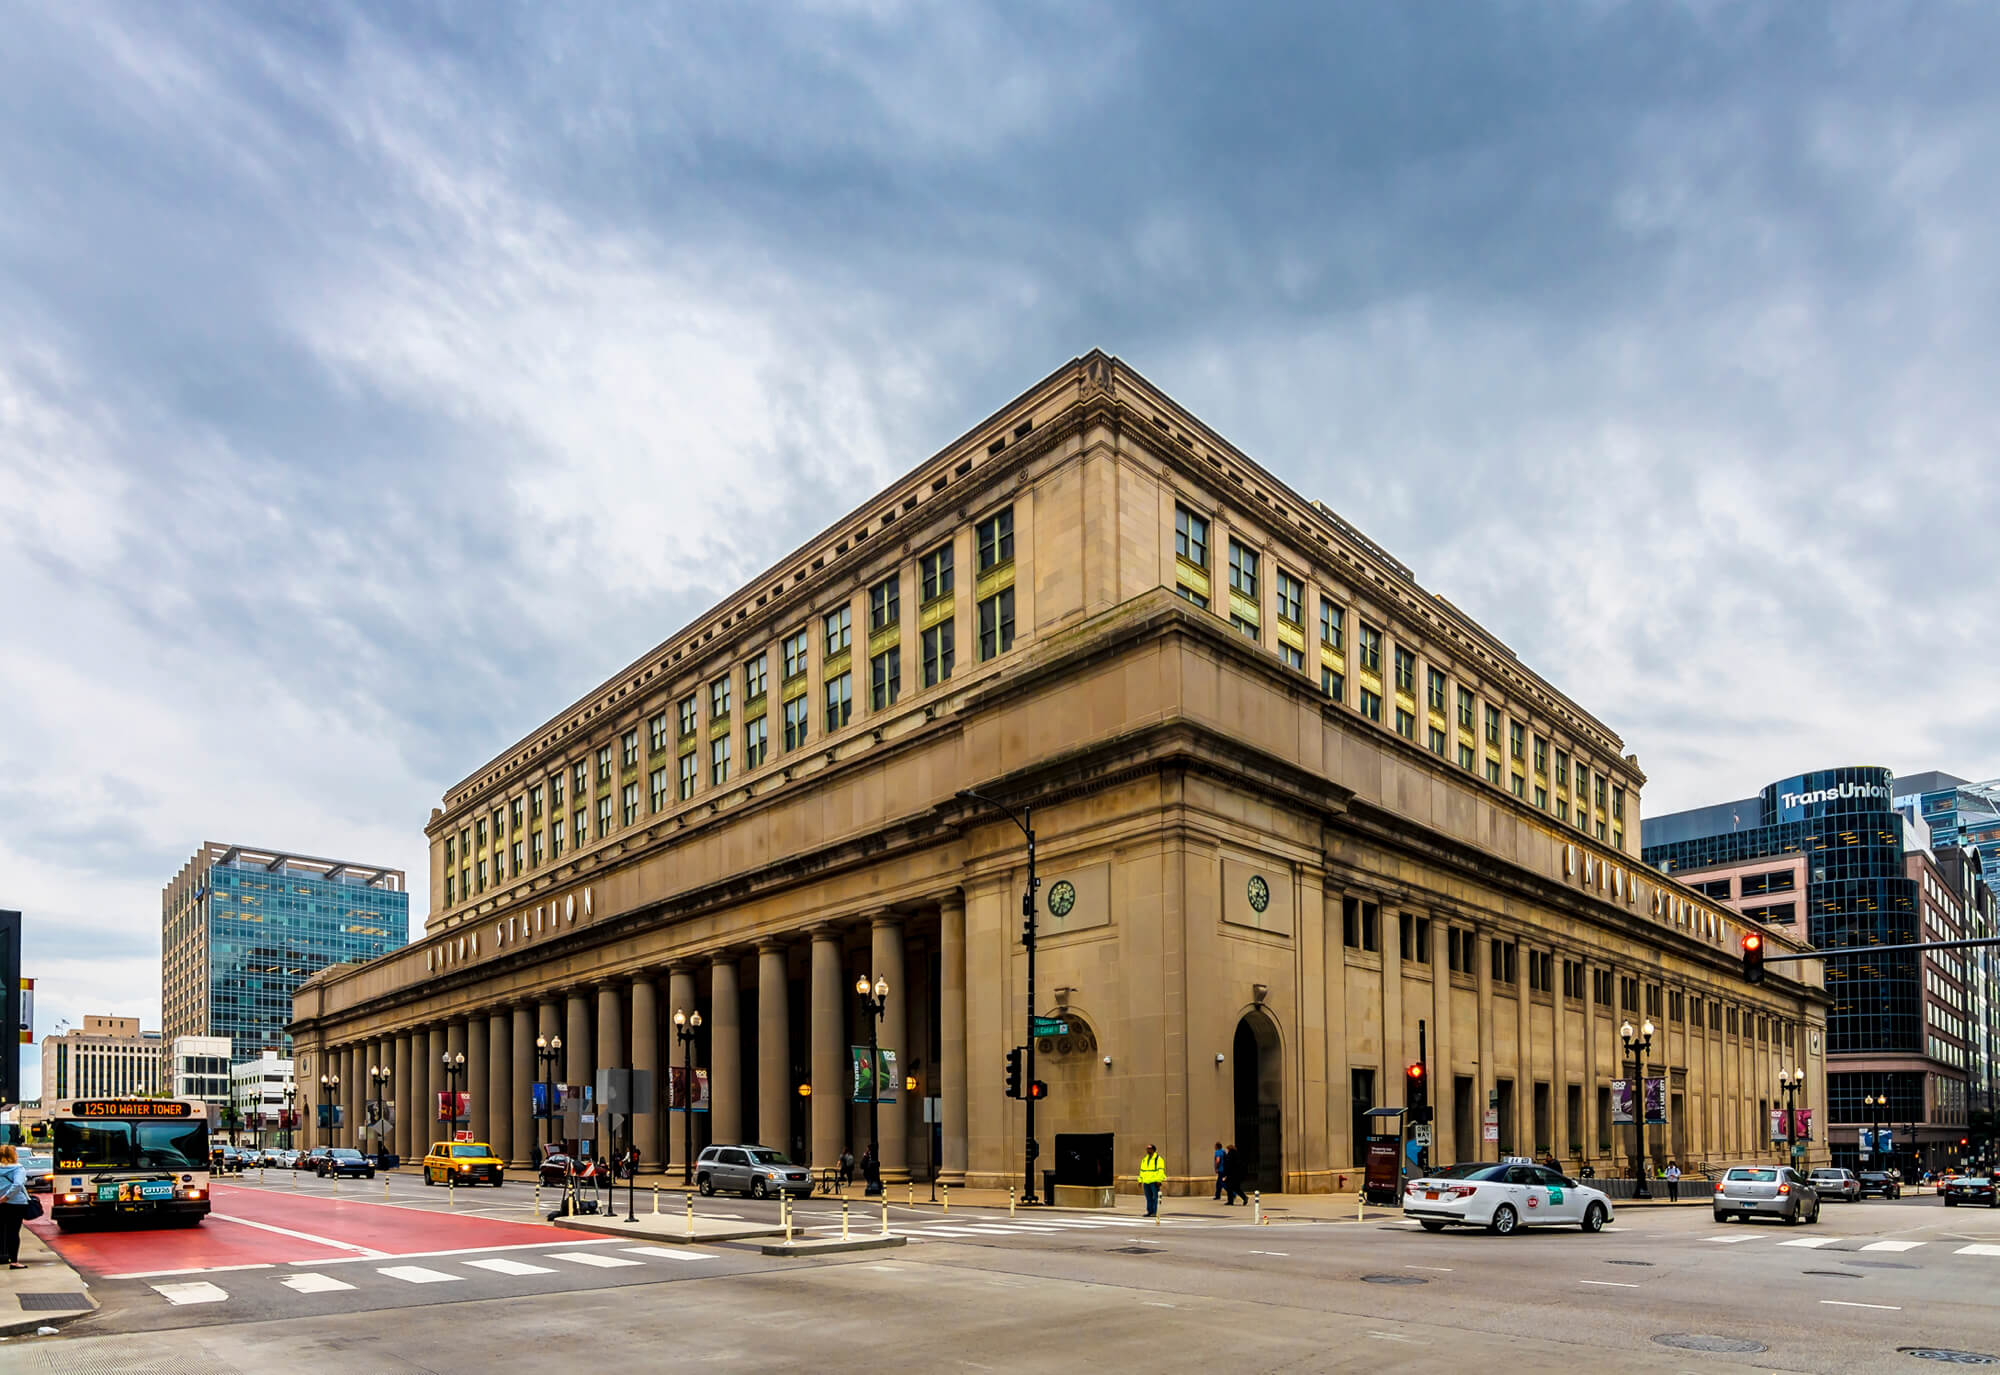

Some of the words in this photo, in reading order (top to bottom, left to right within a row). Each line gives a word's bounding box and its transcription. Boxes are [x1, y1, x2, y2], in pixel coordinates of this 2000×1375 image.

[1781, 782, 1890, 809] TransUnion
[1564, 844, 1637, 904] UNION
[1654, 888, 1725, 942] STATION
[427, 931, 480, 971] UNION
[497, 887, 594, 947] STATION
[84, 1103, 105, 1115] 125
[119, 1104, 150, 1115] WATER
[153, 1104, 182, 1115] TOWER
